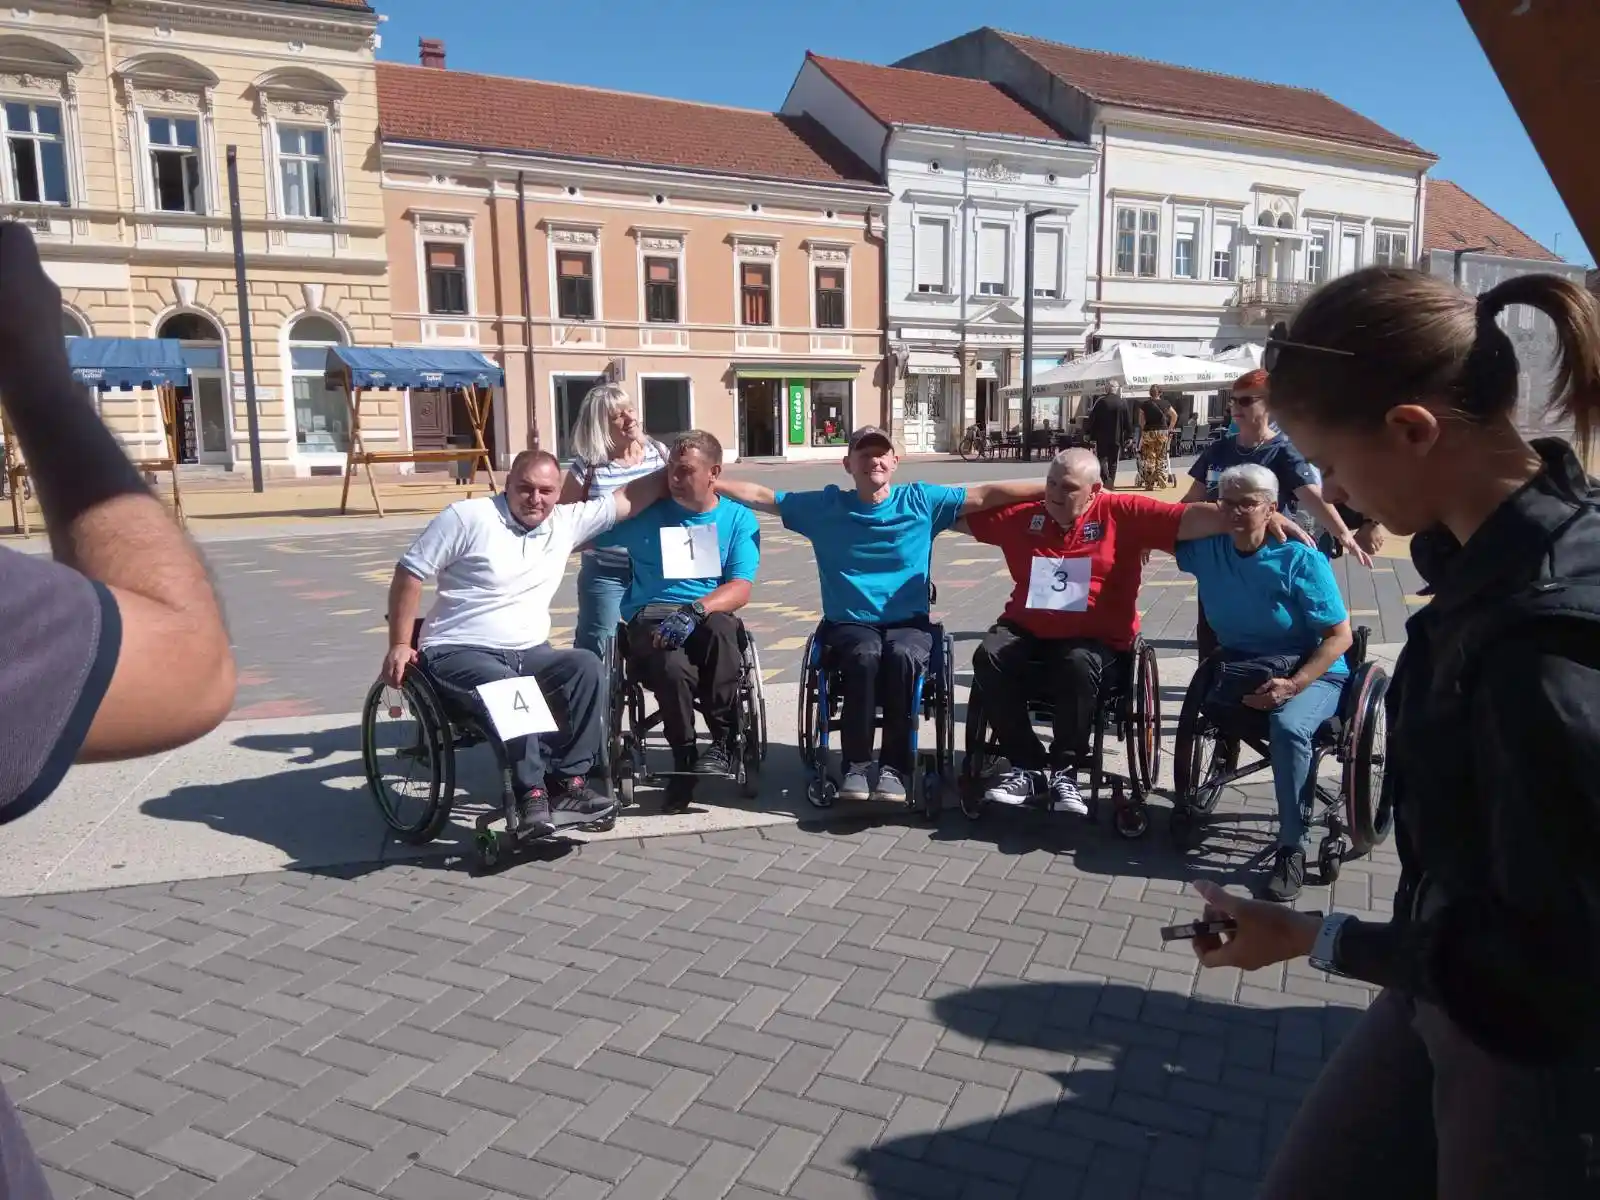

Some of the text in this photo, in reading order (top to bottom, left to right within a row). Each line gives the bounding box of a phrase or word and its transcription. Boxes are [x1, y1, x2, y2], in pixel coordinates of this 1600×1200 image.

[1132, 375, 1148, 383] PAN
[1164, 374, 1180, 383] PAN
[683, 538, 695, 561] 1
[1051, 570, 1068, 592] 3
[513, 689, 530, 713] 4
